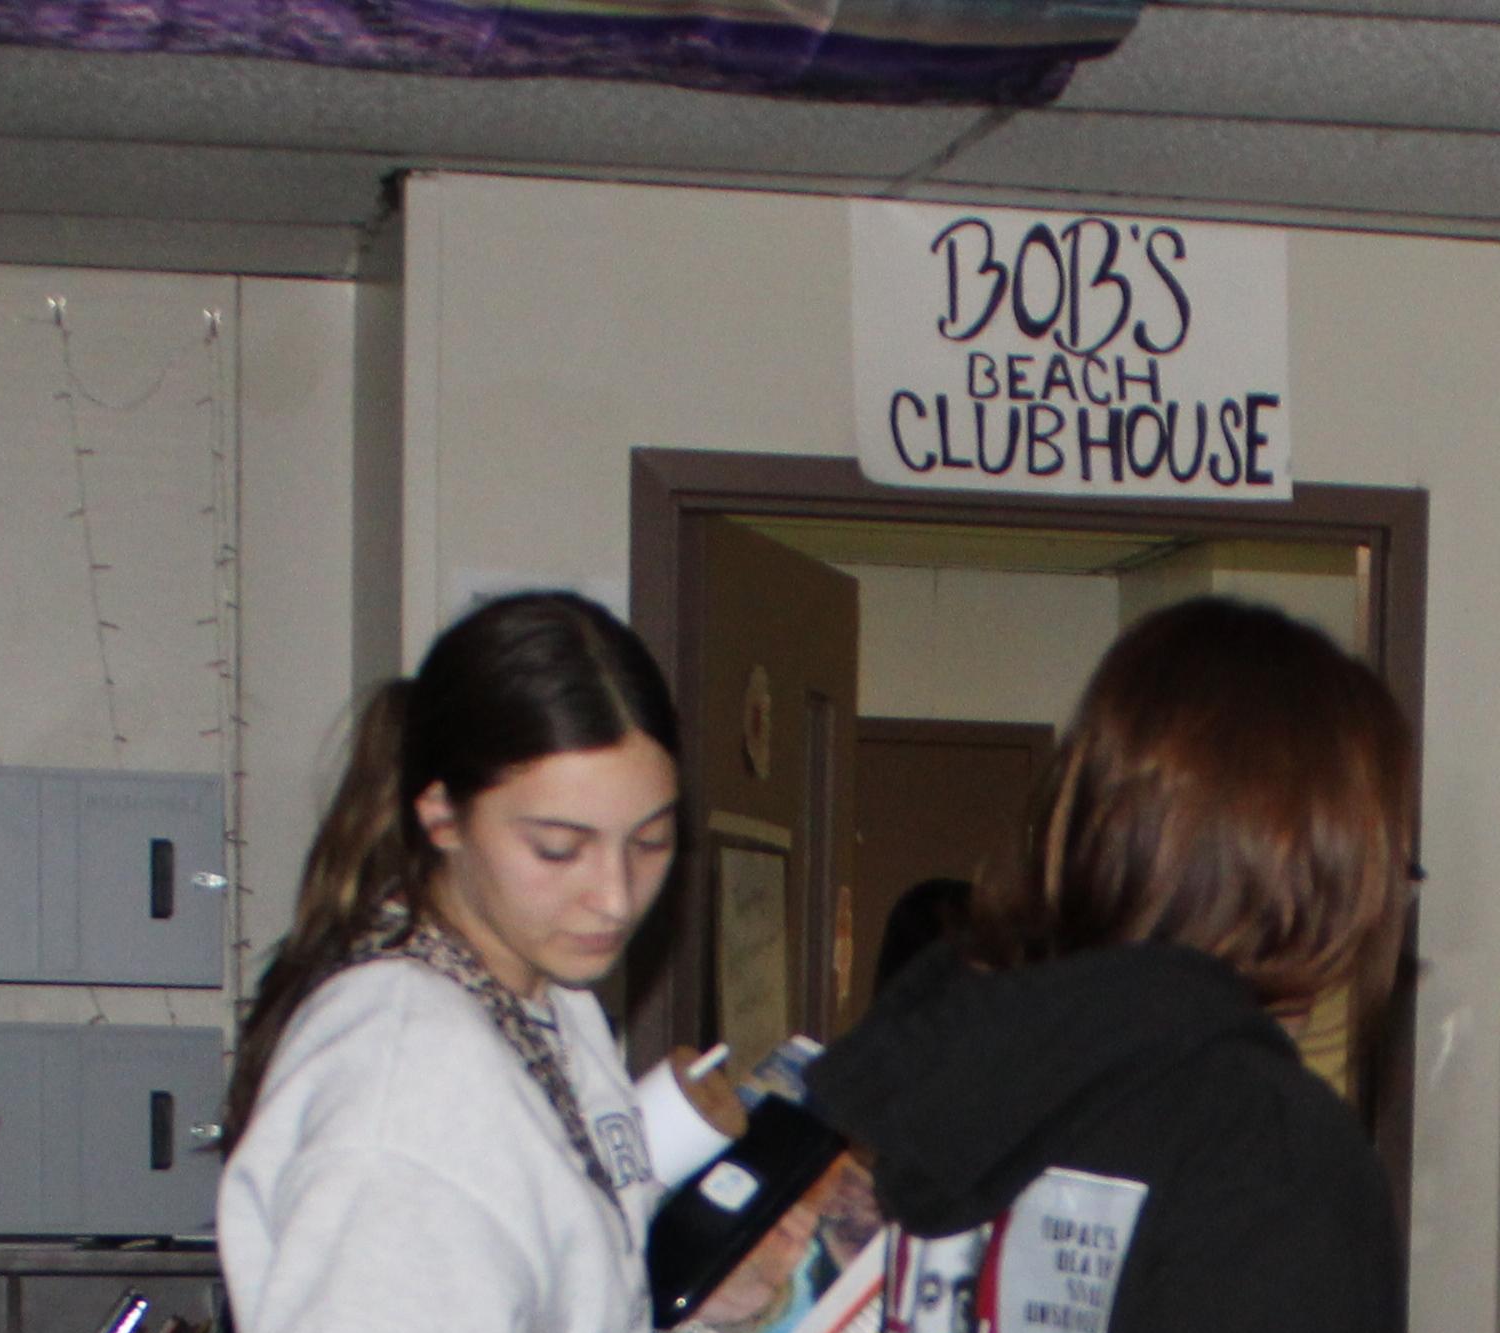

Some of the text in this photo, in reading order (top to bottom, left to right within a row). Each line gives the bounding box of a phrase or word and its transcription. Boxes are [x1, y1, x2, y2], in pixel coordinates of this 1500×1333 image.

[931, 217, 1191, 355] BOB'S
[968, 351, 1162, 406] BEACH
[890, 388, 1282, 488] CLUBHOUSE
